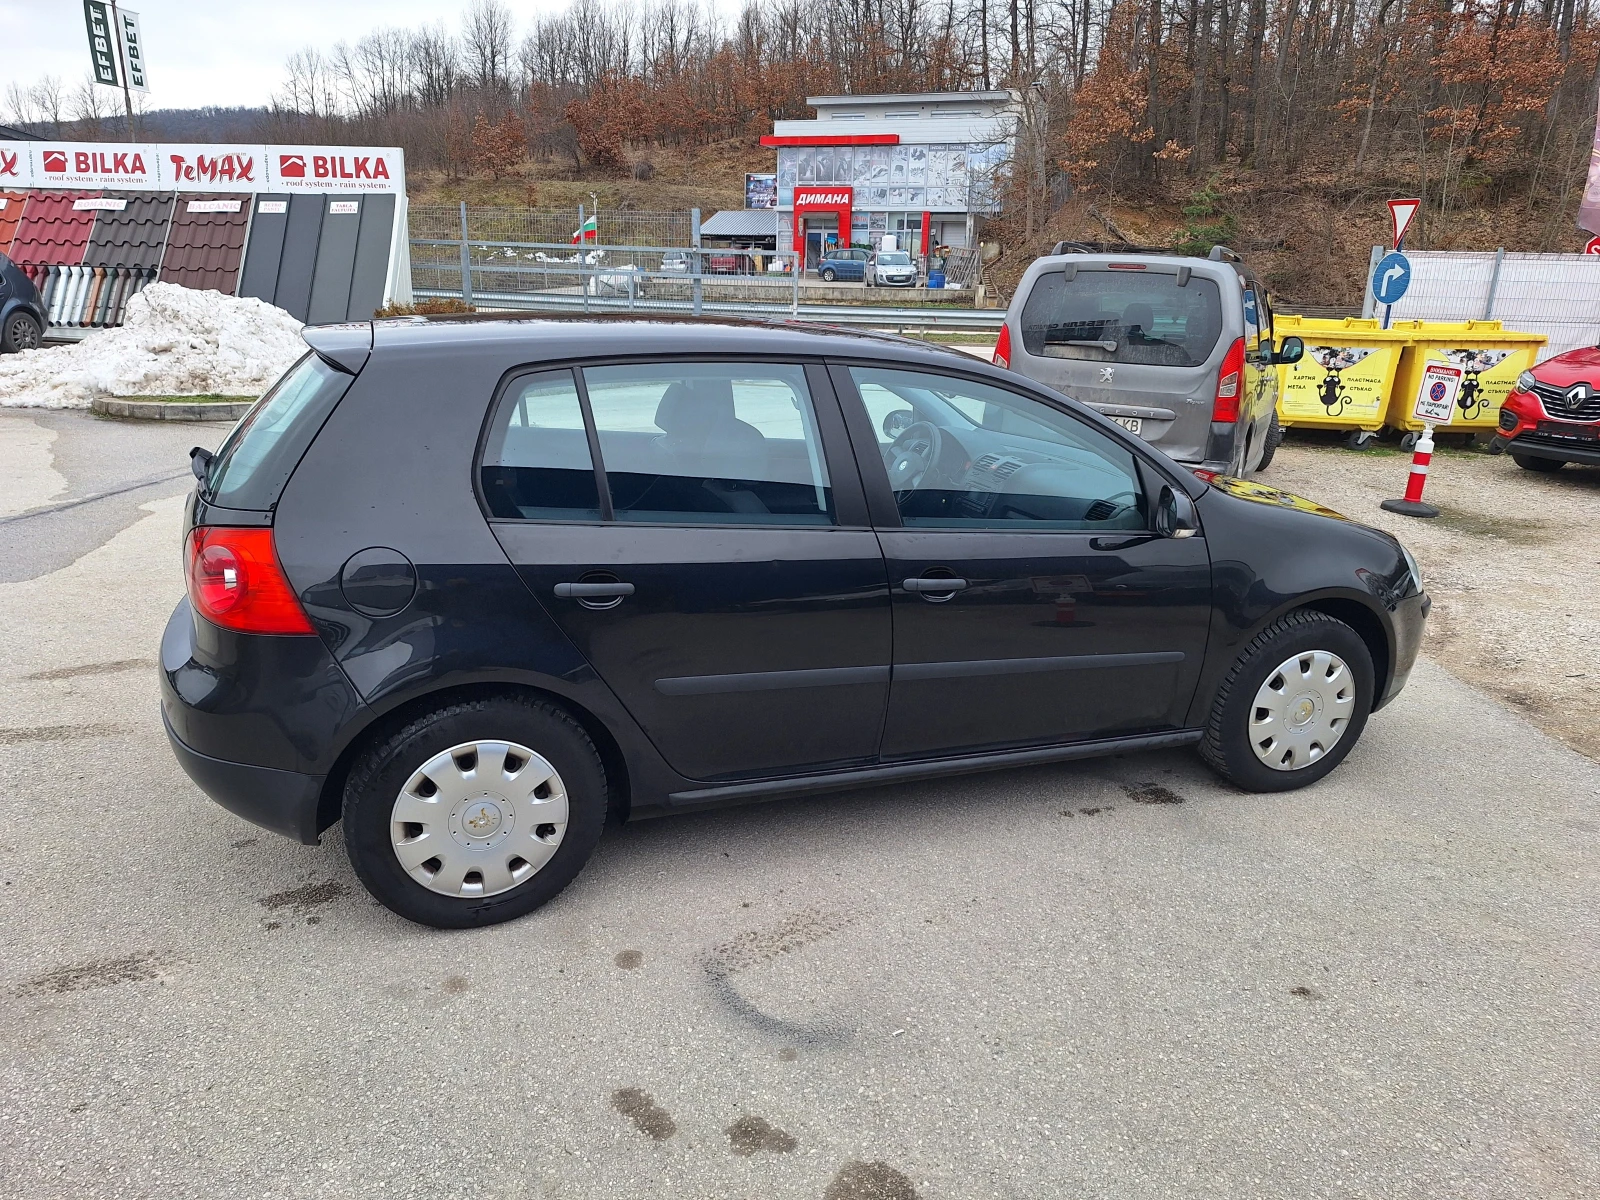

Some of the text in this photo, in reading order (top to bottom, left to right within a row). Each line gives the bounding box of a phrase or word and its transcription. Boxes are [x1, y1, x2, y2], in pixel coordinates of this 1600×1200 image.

[89, 4, 112, 81] EFBET
[123, 14, 144, 87] EFBET
[75, 151, 147, 174] BILKA
[313, 155, 390, 180] BILKA
[66, 175, 93, 184] system
[99, 175, 115, 183] rain
[117, 176, 143, 184] system
[286, 179, 387, 190] roof system rain system
[796, 193, 849, 205] ДИМАНА
[189, 202, 241, 210] BALCANIC
[1099, 407, 1155, 417] GEOT
